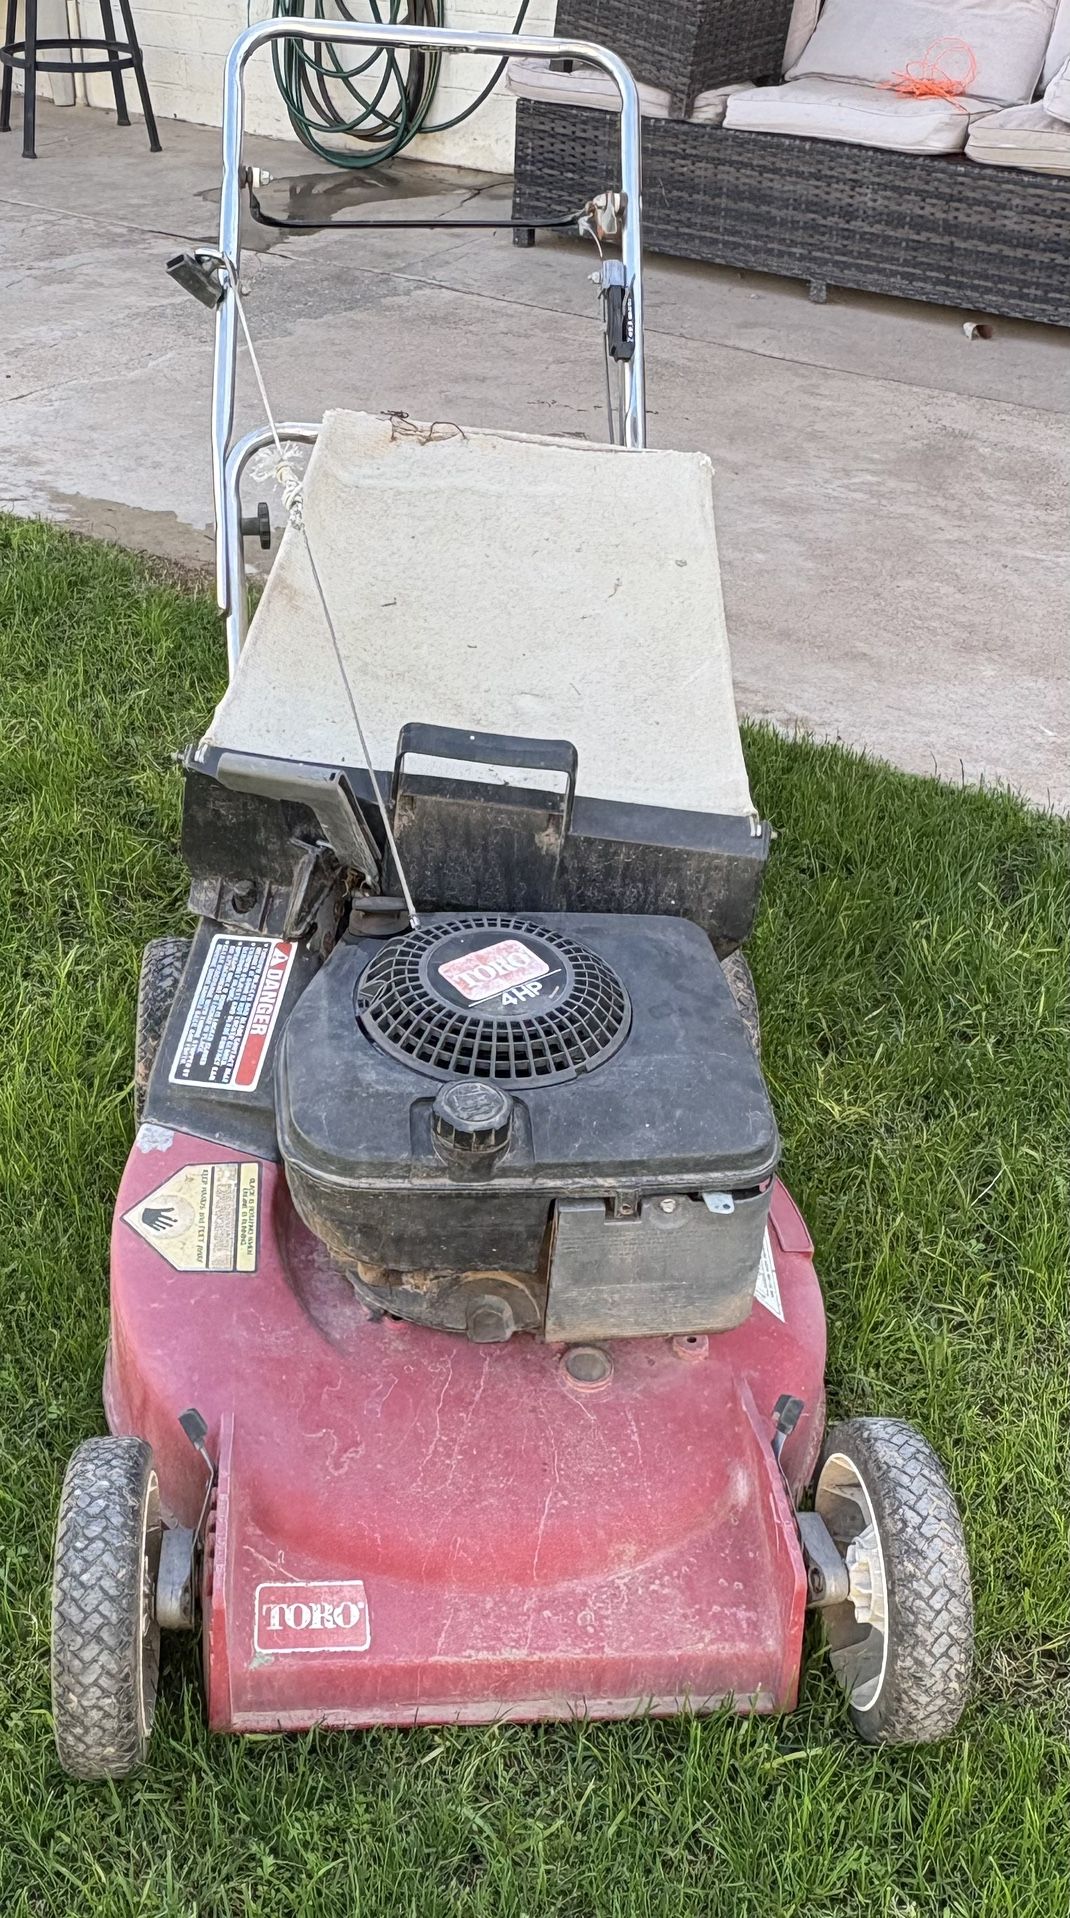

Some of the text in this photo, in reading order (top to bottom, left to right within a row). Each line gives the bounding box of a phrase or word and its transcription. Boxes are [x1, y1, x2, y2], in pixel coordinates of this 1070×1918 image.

[455, 951, 530, 988] TORO
[251, 968, 284, 1036] DANGER
[262, 1601, 360, 1630] TORO
